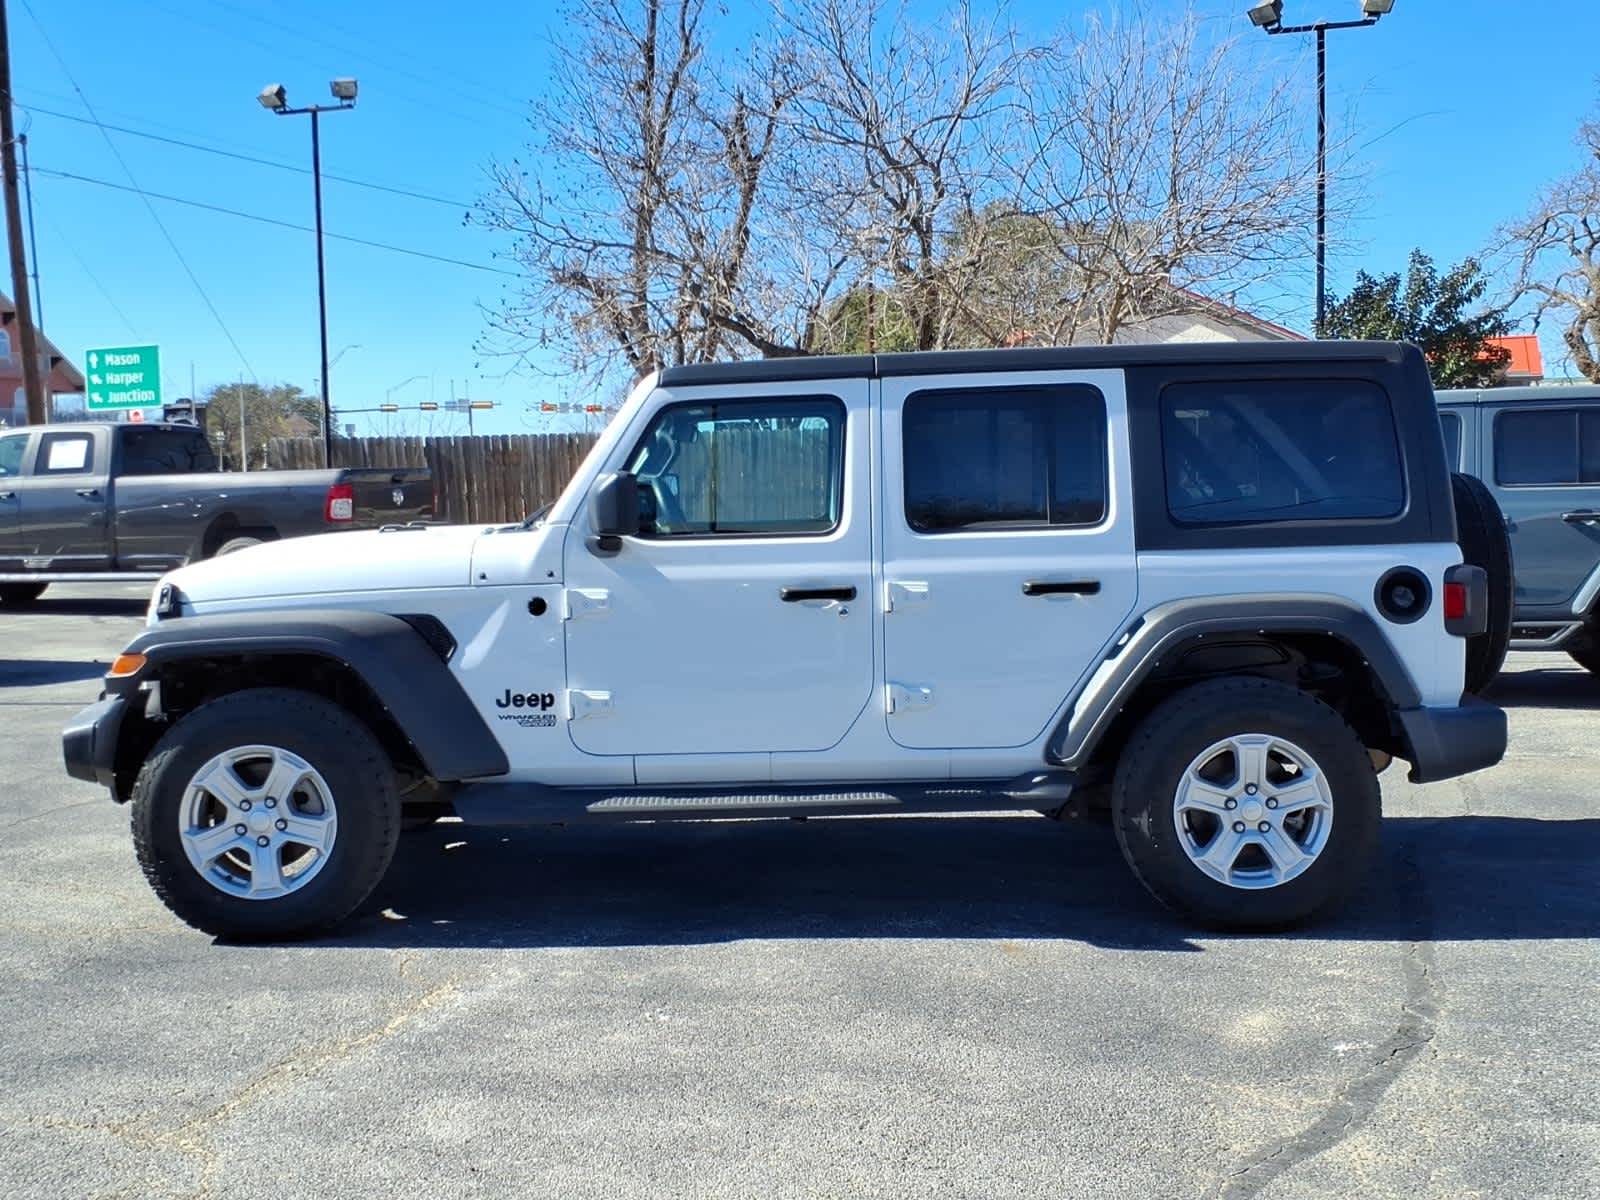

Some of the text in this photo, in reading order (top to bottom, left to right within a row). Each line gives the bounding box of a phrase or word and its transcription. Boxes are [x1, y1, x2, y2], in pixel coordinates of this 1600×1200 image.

[105, 353, 141, 366] Mason
[105, 372, 144, 387] Harper
[108, 389, 156, 403] Junction
[496, 689, 555, 711] Jeep
